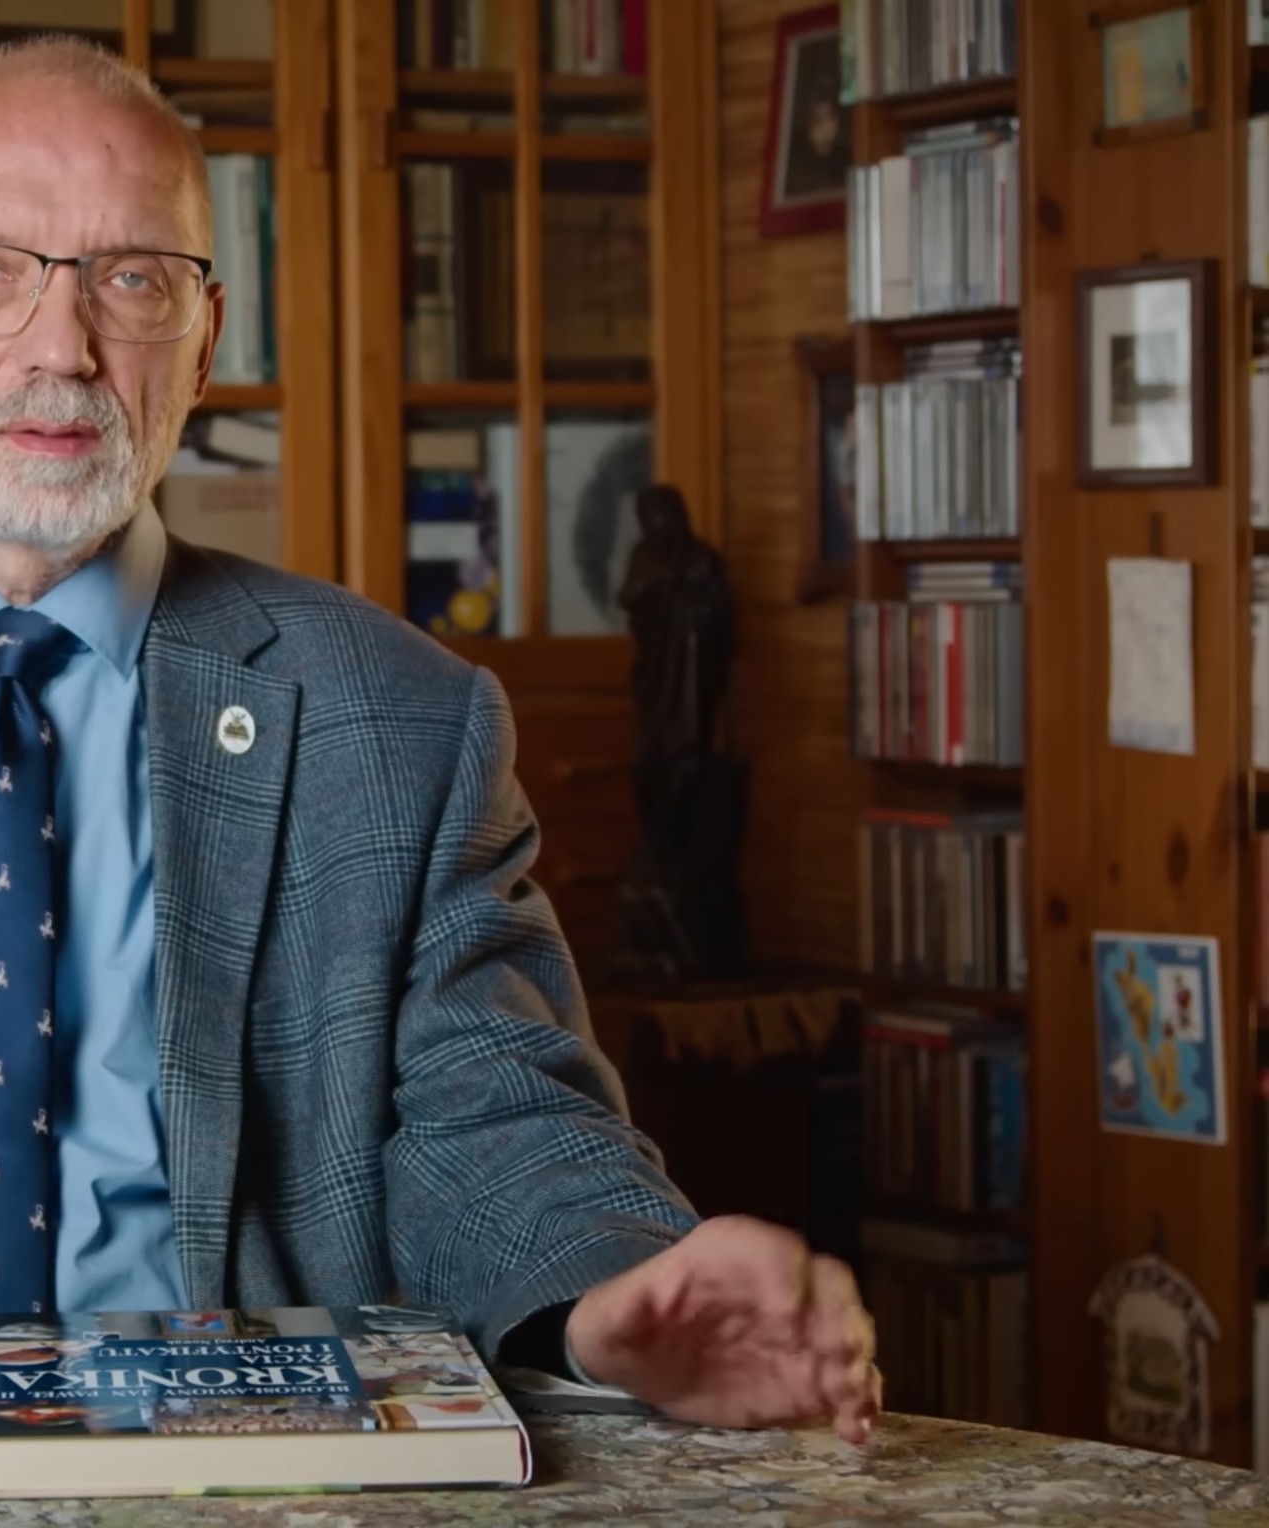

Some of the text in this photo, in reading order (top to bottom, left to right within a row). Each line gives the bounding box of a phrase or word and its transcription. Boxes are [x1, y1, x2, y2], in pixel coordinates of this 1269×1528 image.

[98, 1344, 332, 1357] I PONTYFIKATU
[240, 1354, 336, 1364] ŻYCIA
[0, 1365, 346, 1390] KRONIKA
